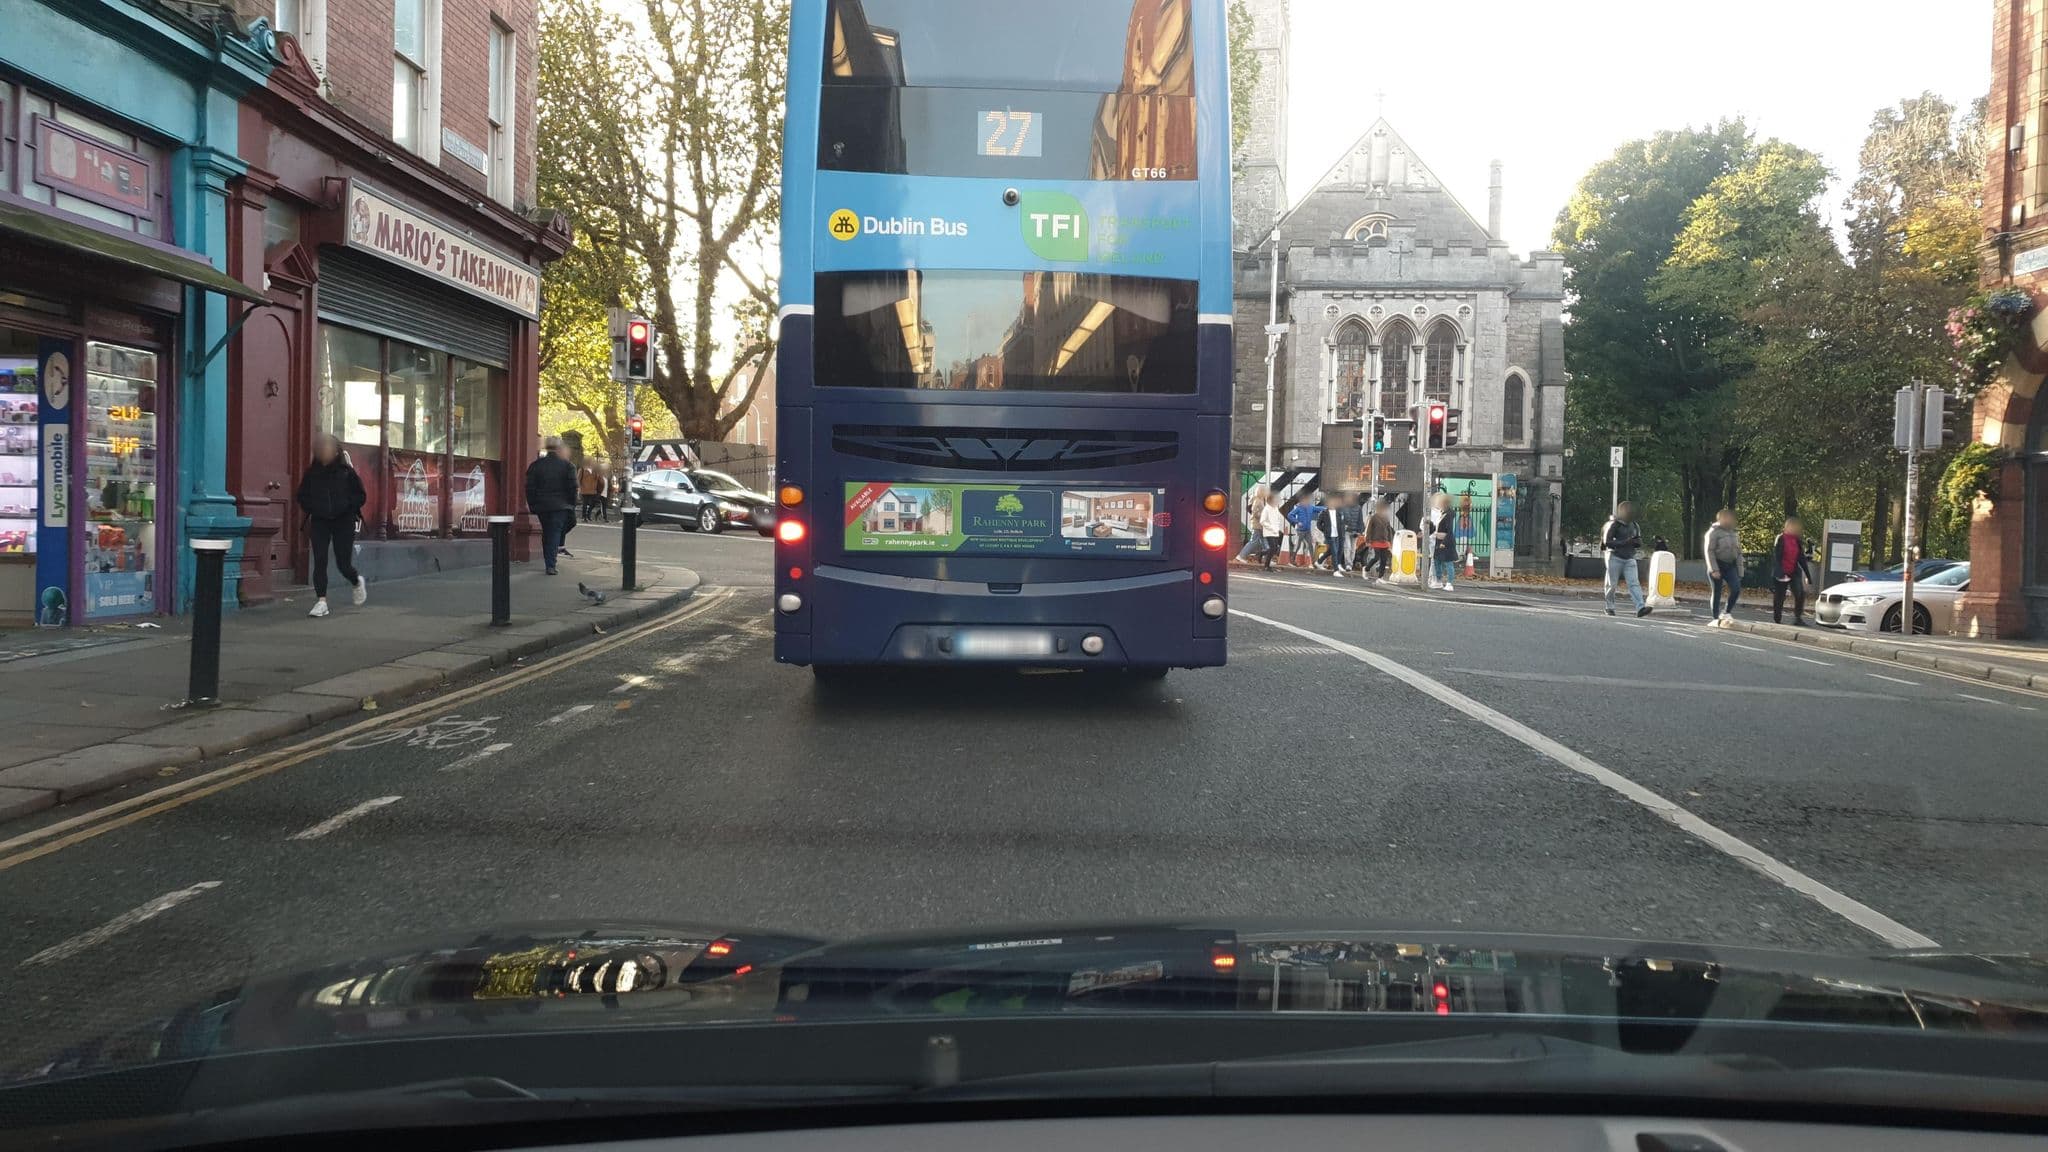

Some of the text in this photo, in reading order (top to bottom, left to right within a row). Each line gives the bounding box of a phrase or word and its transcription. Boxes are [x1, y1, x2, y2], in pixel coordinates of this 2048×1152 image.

[986, 111, 1031, 155] 27
[1131, 167, 1167, 178] GT66
[863, 216, 968, 236] Dublin Bus
[1030, 213, 1081, 239] TFI
[374, 211, 523, 303] MARIO'S TAKEAWAY
[51, 432, 65, 518] Lycamobile
[972, 515, 1047, 528] RAHENNY PARK
[885, 538, 936, 547] rahennypark.ie
